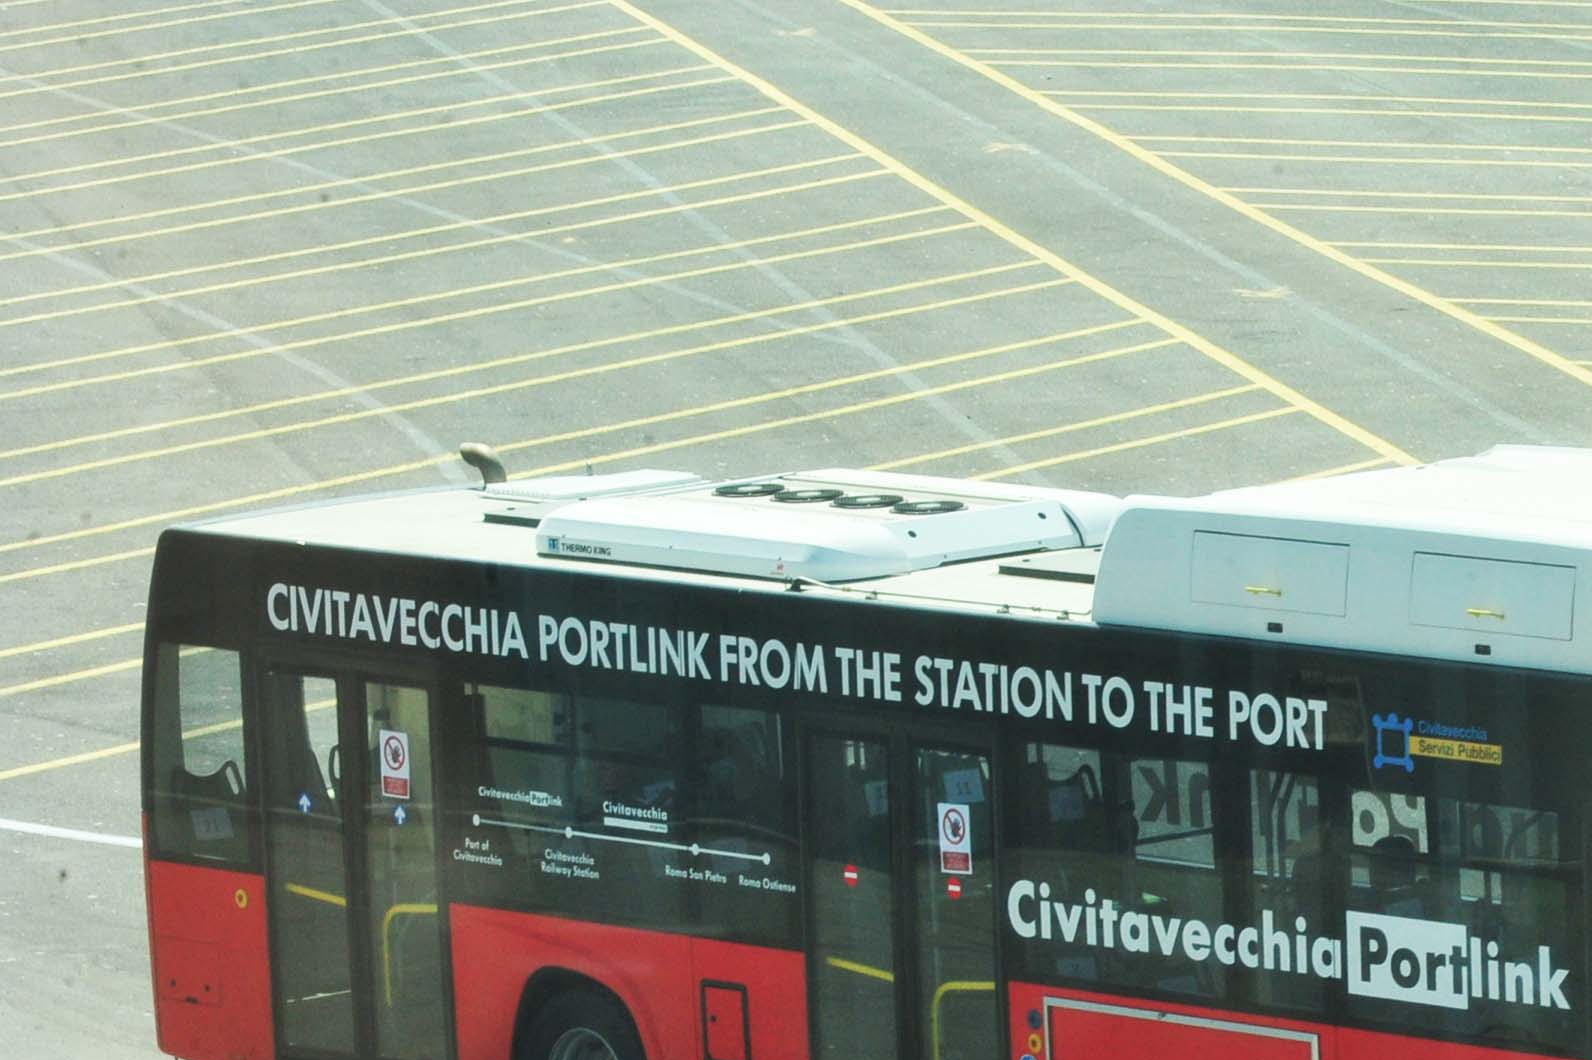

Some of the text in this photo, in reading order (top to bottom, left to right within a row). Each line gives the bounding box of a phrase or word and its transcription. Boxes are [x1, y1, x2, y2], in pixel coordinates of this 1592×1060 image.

[561, 543, 613, 557] THERMO KING
[267, 582, 1328, 751] CIVITAVECCHIA PORTLINK FROM THE STATION TO THE PORT
[1418, 720, 1488, 741] Civitavecchia
[1418, 739, 1500, 761] Servizi Pubblici
[602, 800, 668, 821] Civitavecchia
[453, 849, 503, 866] Civitavecchia
[544, 848, 595, 865] Civitavecchia
[540, 860, 600, 880] Railway Station
[665, 864, 727, 884] Roma San Pietro
[738, 874, 796, 893] Roma Ostiense
